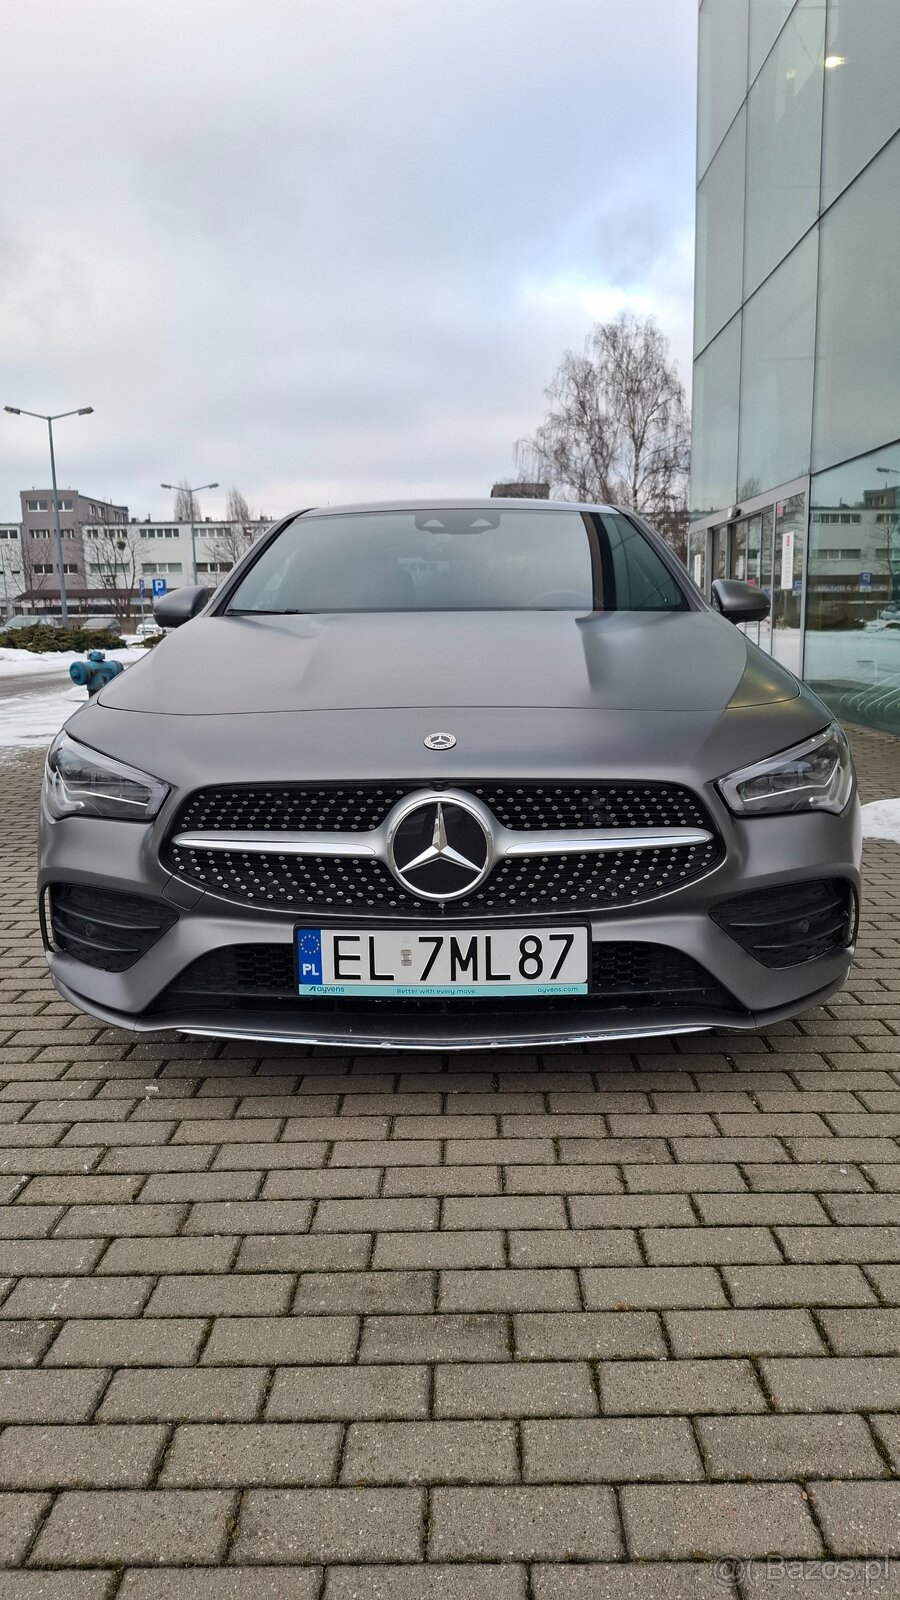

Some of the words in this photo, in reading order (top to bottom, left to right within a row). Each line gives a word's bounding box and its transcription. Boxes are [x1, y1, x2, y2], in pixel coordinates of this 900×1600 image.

[155, 580, 163, 592] P
[333, 935, 394, 981] EL
[418, 933, 575, 982] 7ML87
[302, 963, 320, 976] PL
[316, 985, 345, 994] ayvens
[436, 988, 456, 996] every
[537, 985, 579, 994] ayvens.com
